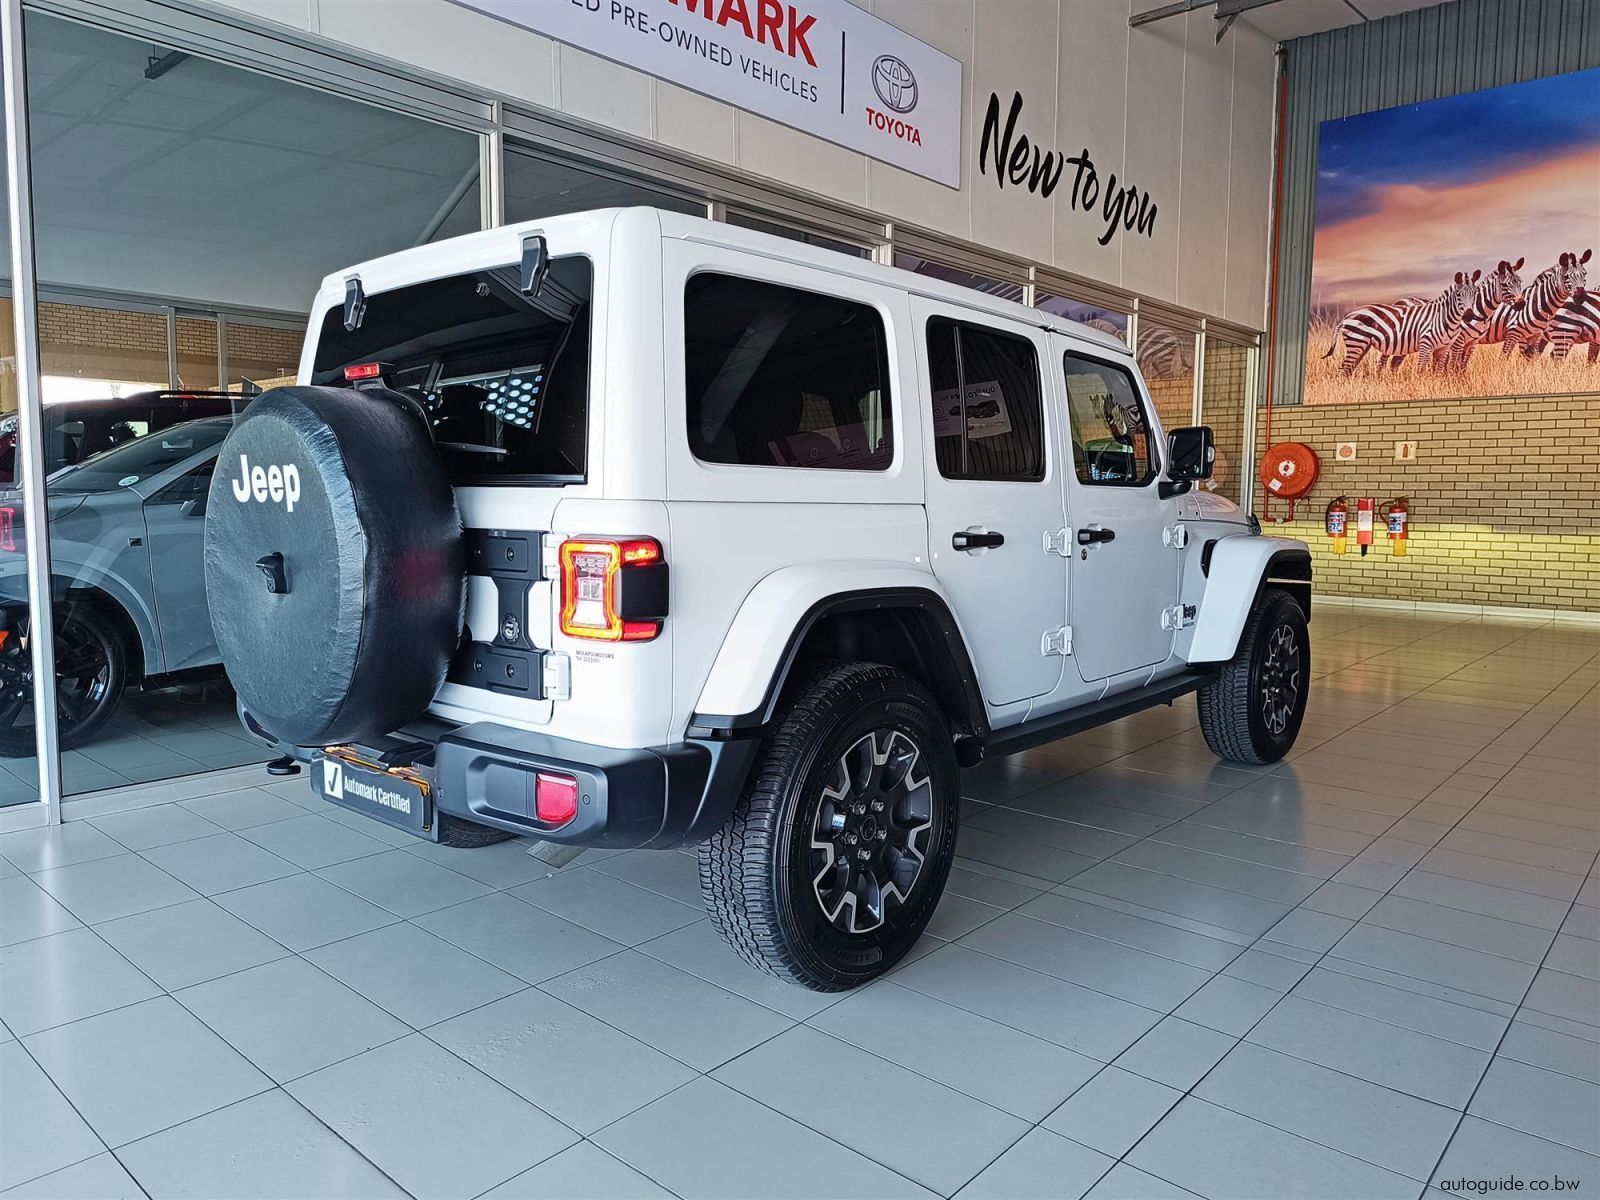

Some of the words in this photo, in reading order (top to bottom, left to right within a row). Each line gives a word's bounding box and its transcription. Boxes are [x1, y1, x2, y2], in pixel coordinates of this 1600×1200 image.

[611, 0, 733, 67] PRE-OWNED
[739, 54, 818, 103] VEHICLES
[866, 107, 922, 147] TOYOTA
[979, 91, 1064, 198] New
[1066, 148, 1099, 211] to
[1098, 173, 1158, 246] you
[232, 454, 301, 513] Jeep
[344, 775, 378, 803] Automark
[377, 787, 411, 814] Certified
